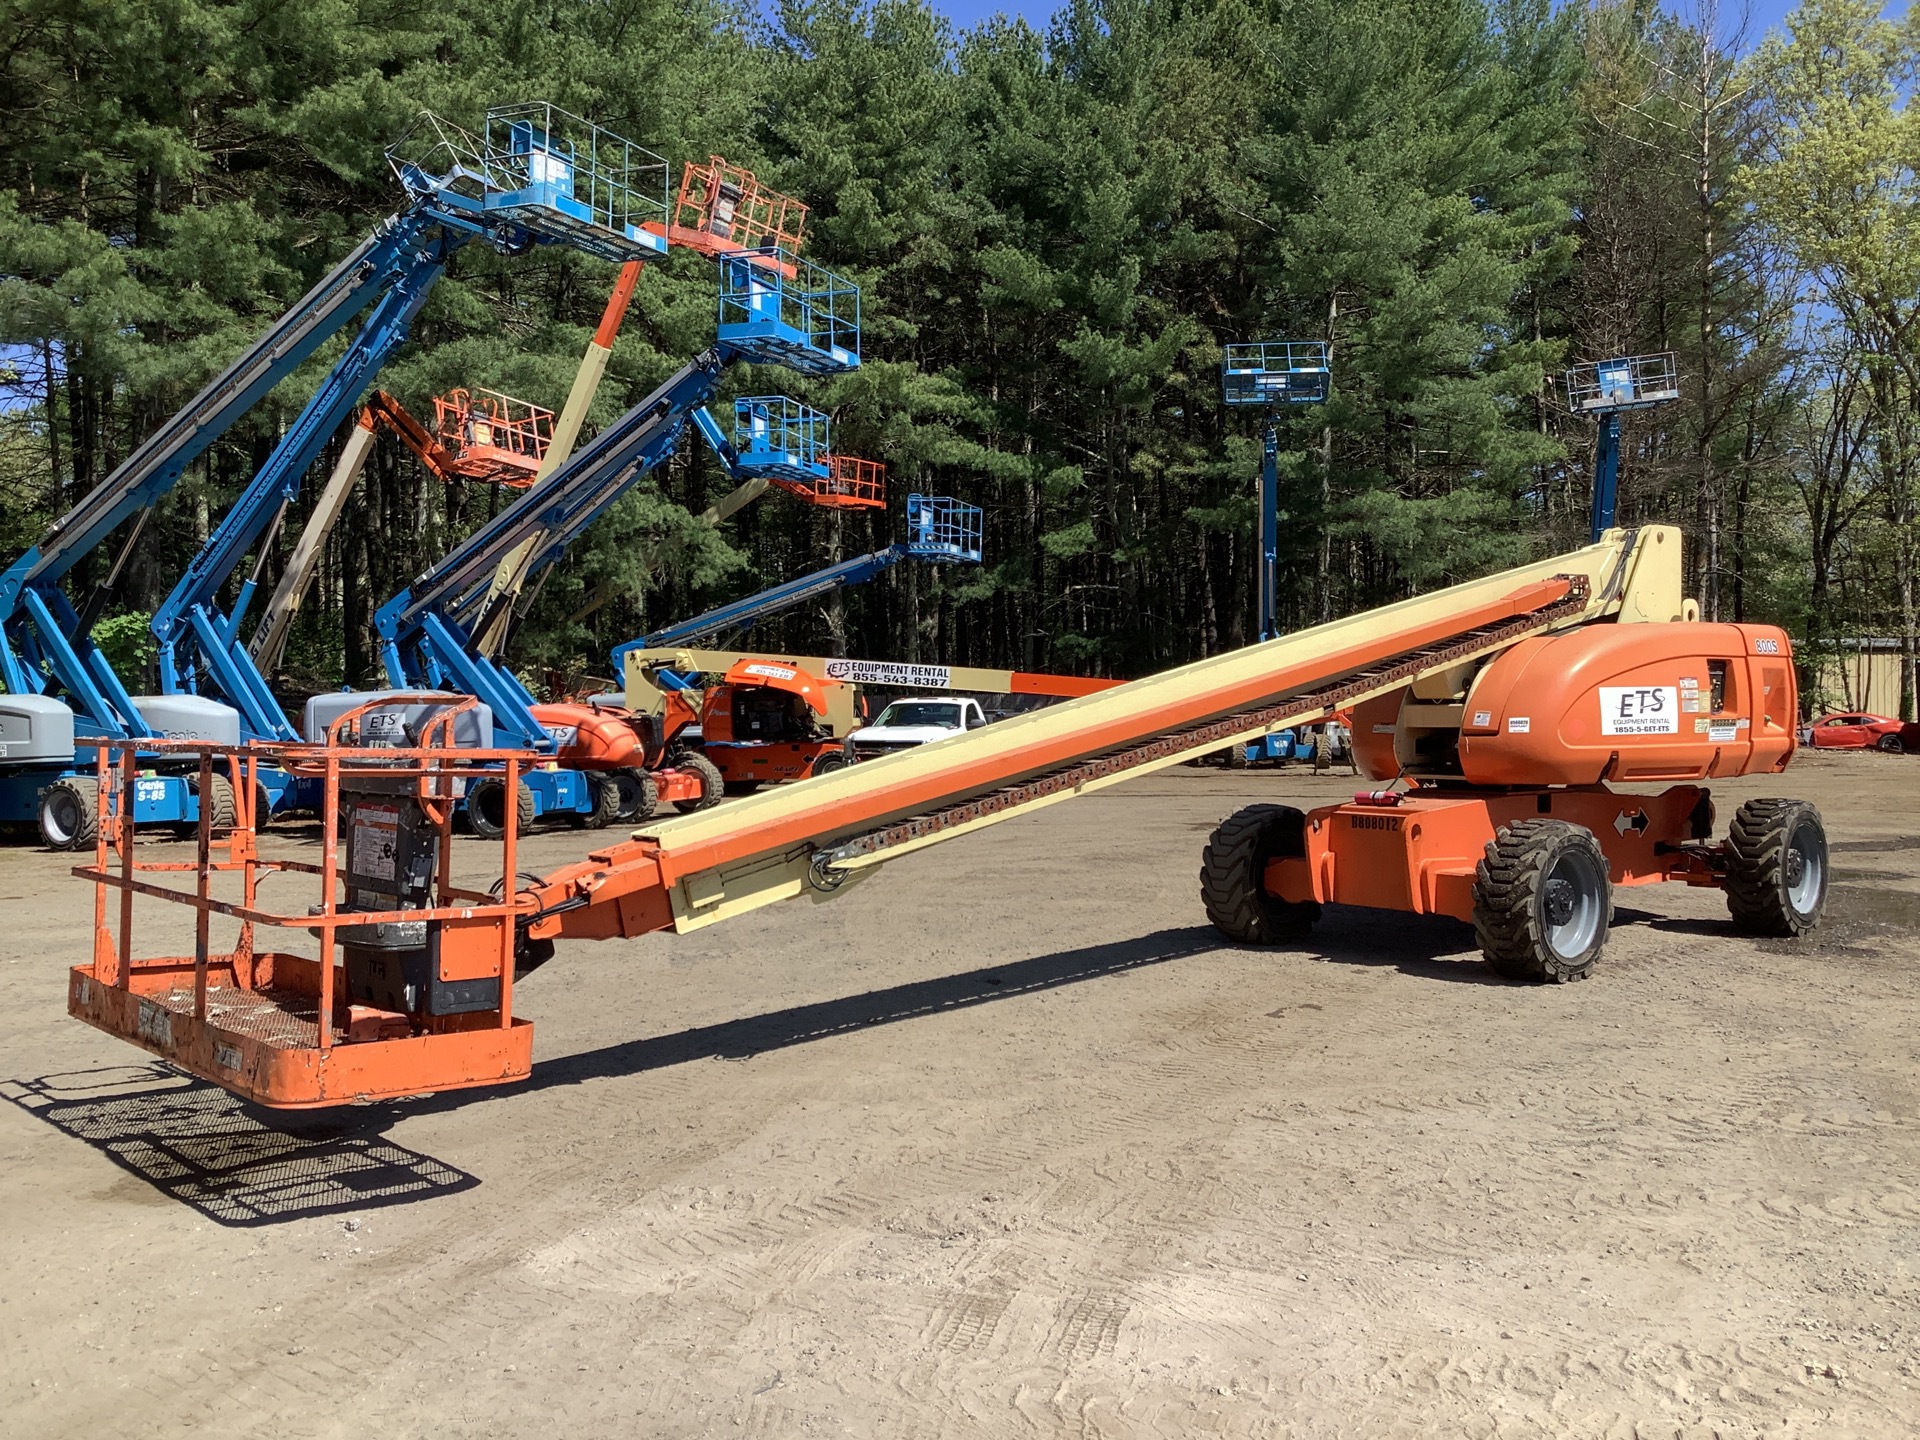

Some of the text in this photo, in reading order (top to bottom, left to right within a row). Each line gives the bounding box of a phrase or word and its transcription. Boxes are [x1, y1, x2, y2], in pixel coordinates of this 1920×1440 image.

[1756, 639, 1778, 653] 800S
[831, 662, 949, 678] ETS EQUIPMENT RENTAL
[853, 673, 947, 687] 855-543-8387
[1620, 688, 1663, 717] ETS
[370, 714, 396, 728] ETS
[137, 781, 165, 791] Genie
